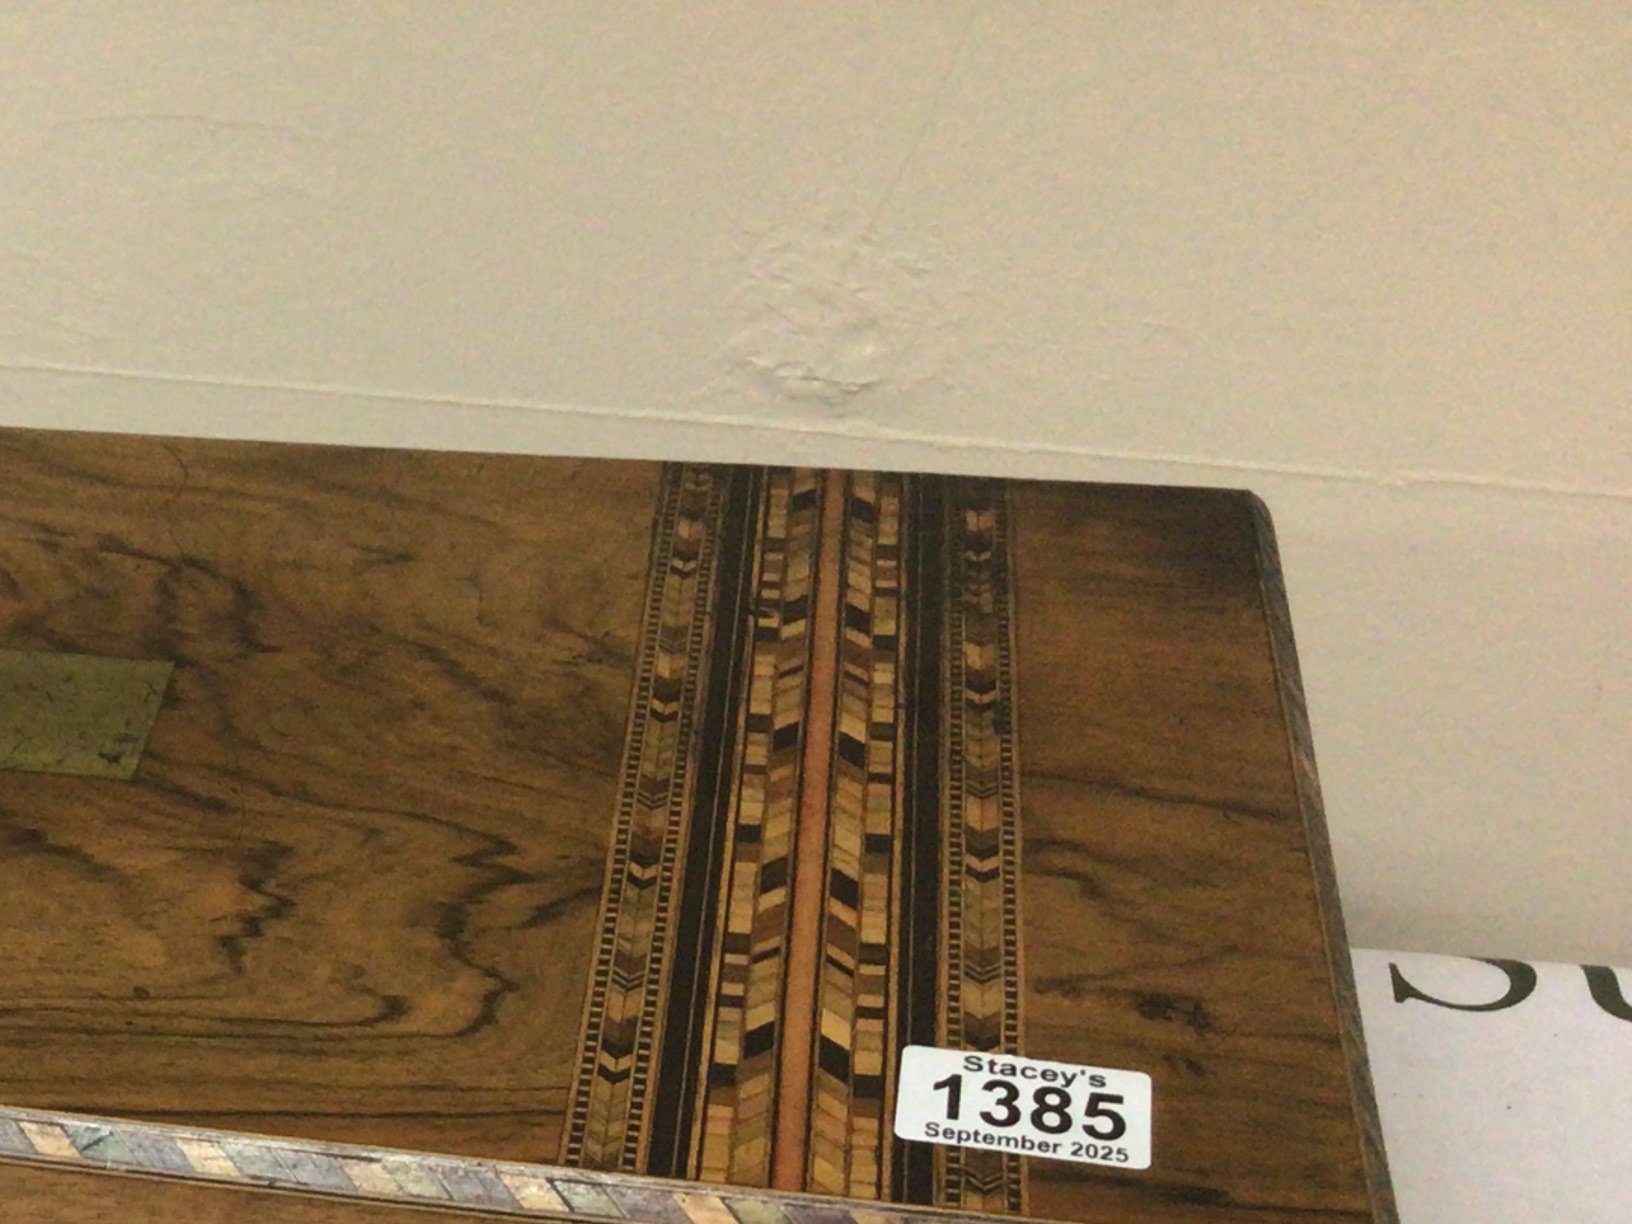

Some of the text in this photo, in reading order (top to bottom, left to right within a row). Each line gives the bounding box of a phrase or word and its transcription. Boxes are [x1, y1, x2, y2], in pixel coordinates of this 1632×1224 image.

[962, 1054, 1107, 1088] Stacey's
[932, 1073, 1128, 1142] 1385
[924, 1122, 1130, 1163] September 2025
